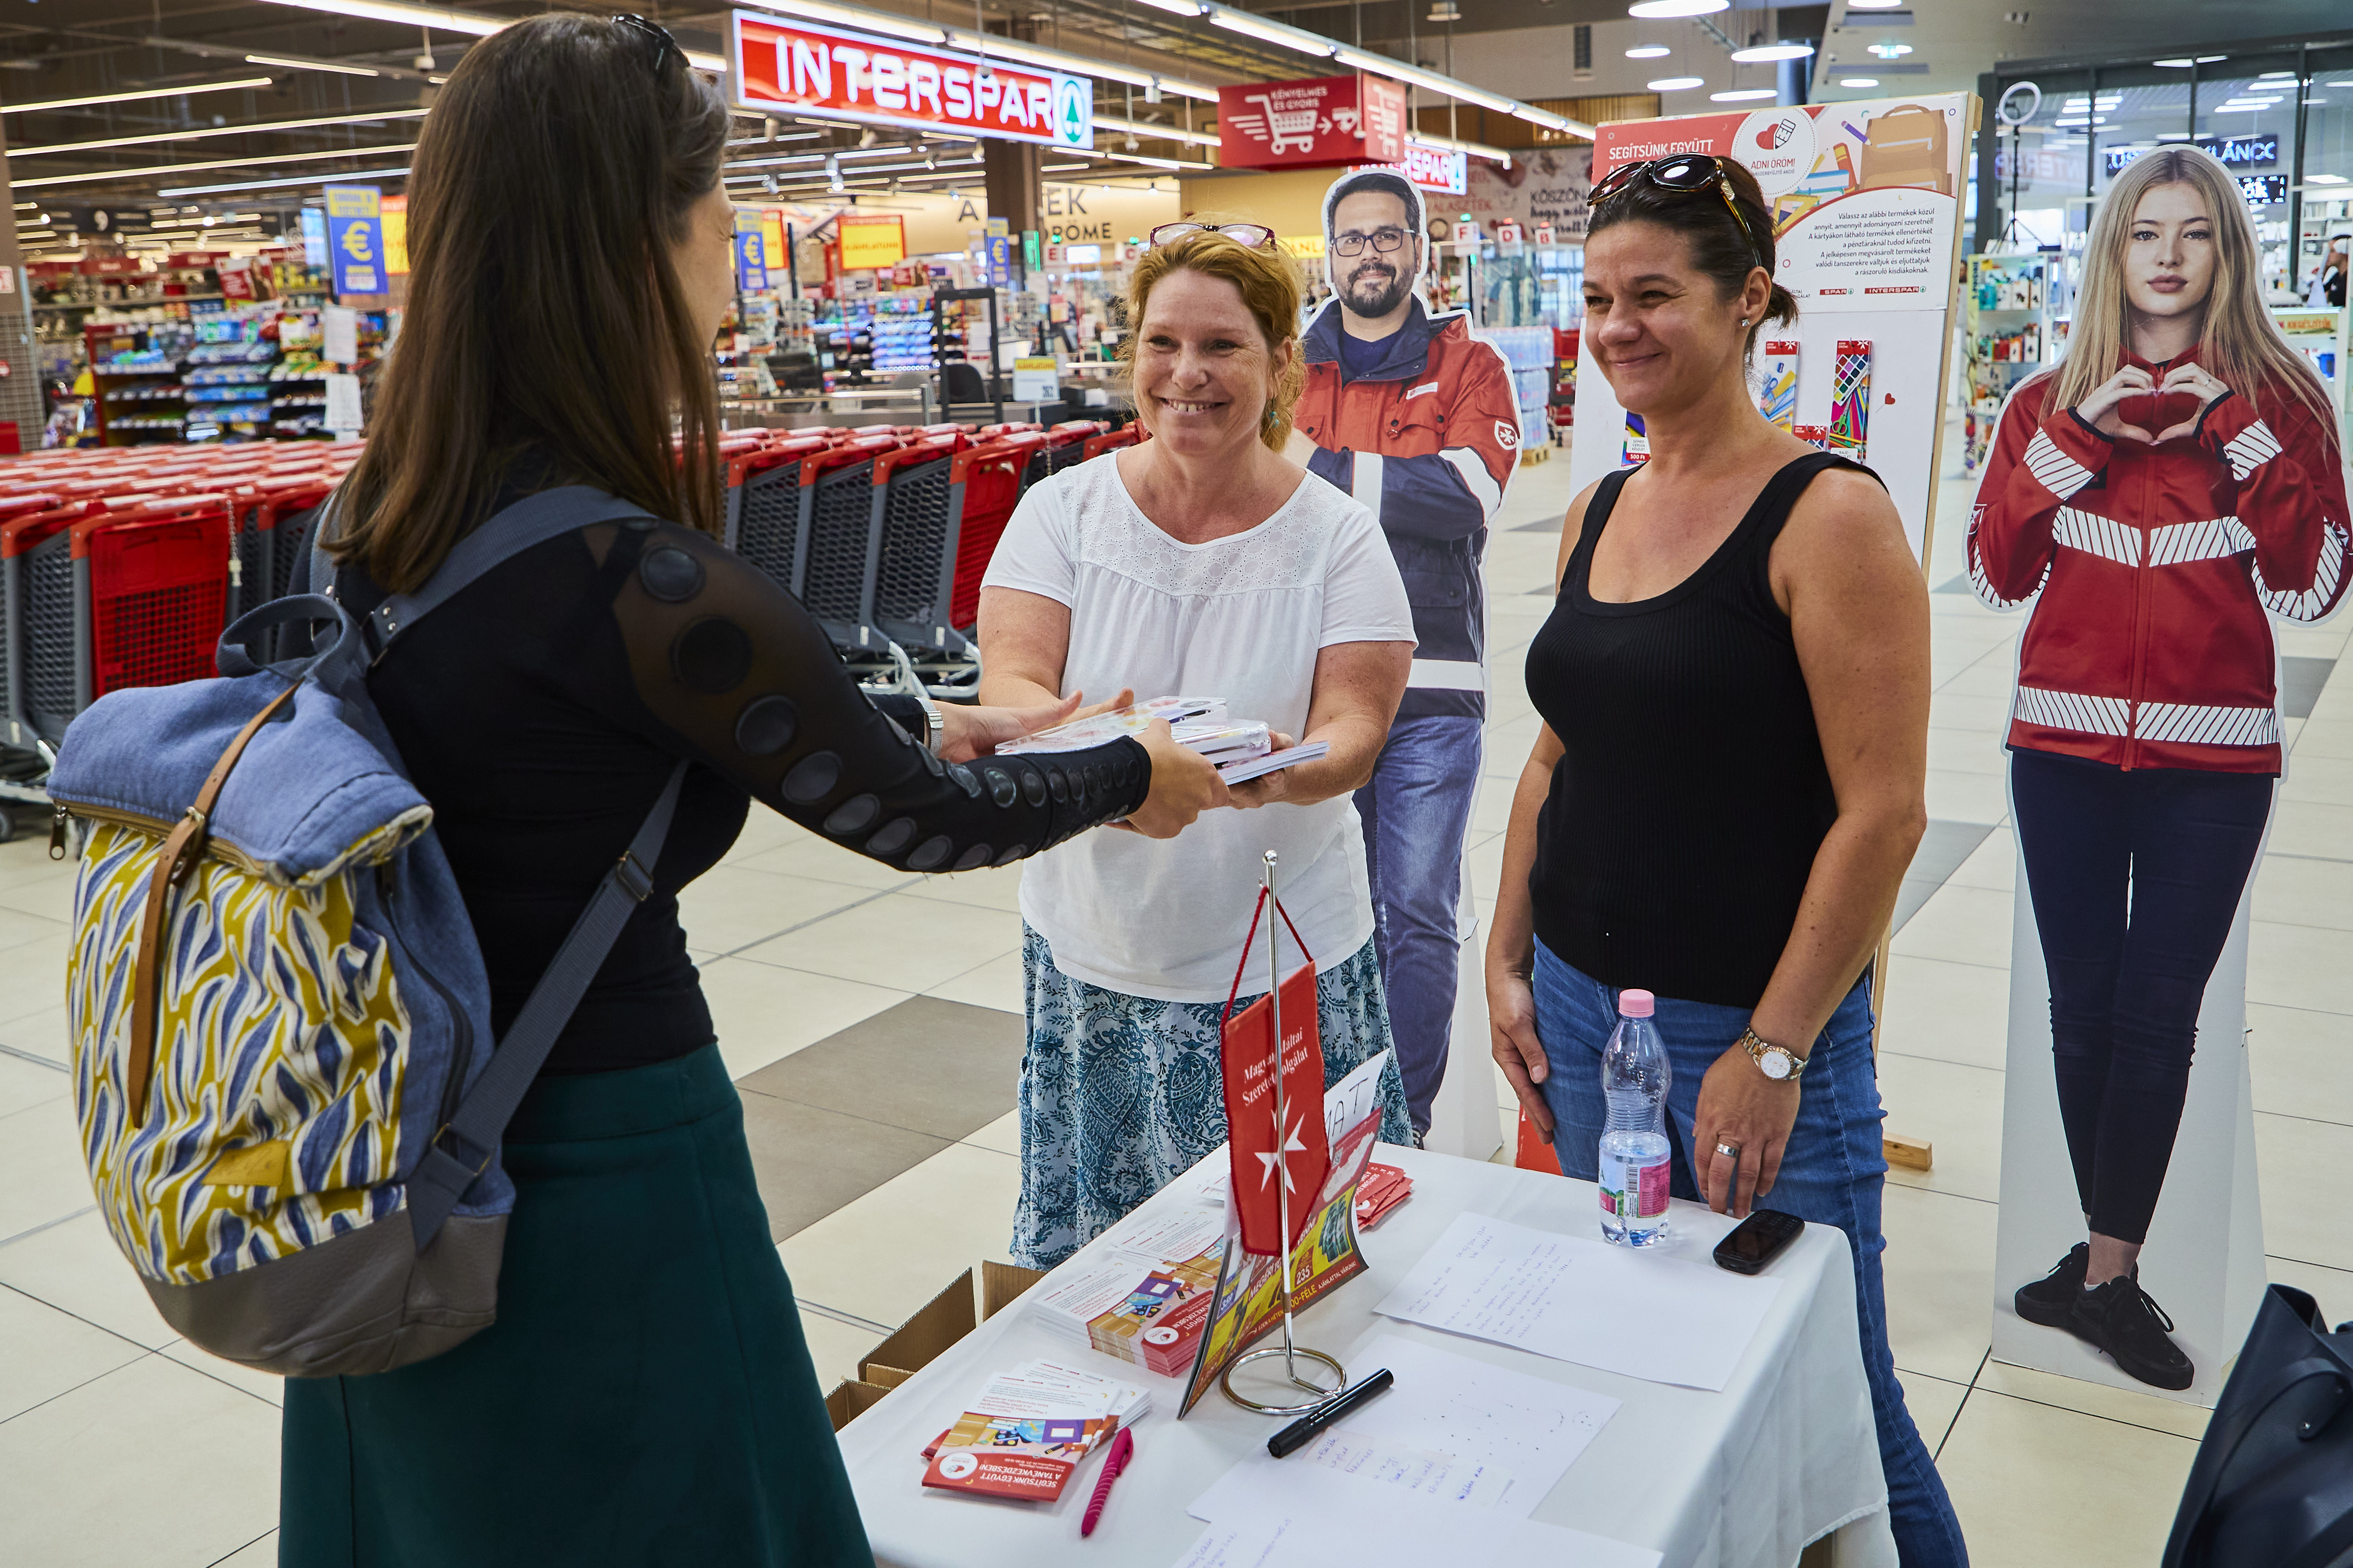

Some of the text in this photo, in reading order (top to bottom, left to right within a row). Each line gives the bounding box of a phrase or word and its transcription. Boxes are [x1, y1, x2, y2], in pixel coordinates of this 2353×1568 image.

[775, 35, 1053, 130] INTERSPAR
[1270, 86, 1328, 100] KÉNYELMES
[1286, 97, 1320, 110] GYORS
[1609, 138, 1714, 160] SEGÍTSÜNK EGYÜTT
[1751, 156, 1796, 169] ADNI ÖRÖM!
[1888, 209, 1916, 217] termékek
[1814, 217, 1934, 232] annyit, amennyit adományozni szeretnél!
[1814, 232, 1843, 241] kártyákon
[1866, 230, 1895, 238] termékek
[1848, 240, 1886, 249] pénztáraknál
[1825, 250, 1857, 259] jelképesen
[1858, 249, 1894, 258] megvásárolt
[1870, 258, 1889, 266] váltjuk
[1899, 257, 1930, 265] eljuttatjuk
[1888, 266, 1929, 274] kisdiákoknak.
[1869, 286, 1919, 294] INTERSPAR
[1242, 1045, 1309, 1106] Szeretetolgálat
[1296, 1265, 1310, 1285] 235
[1258, 1320, 1268, 1330] EZEN
[1318, 1272, 1341, 1289] AJÁNLATTAL
[1340, 1260, 1356, 1277] VÁRUNK!
[1184, 1315, 1206, 1330] EGYÜTT
[979, 1463, 1053, 1479] TANÉVKEZDÉSBEN!
[980, 1472, 1057, 1488] SEGÍTSÜNK EGYÜTT
